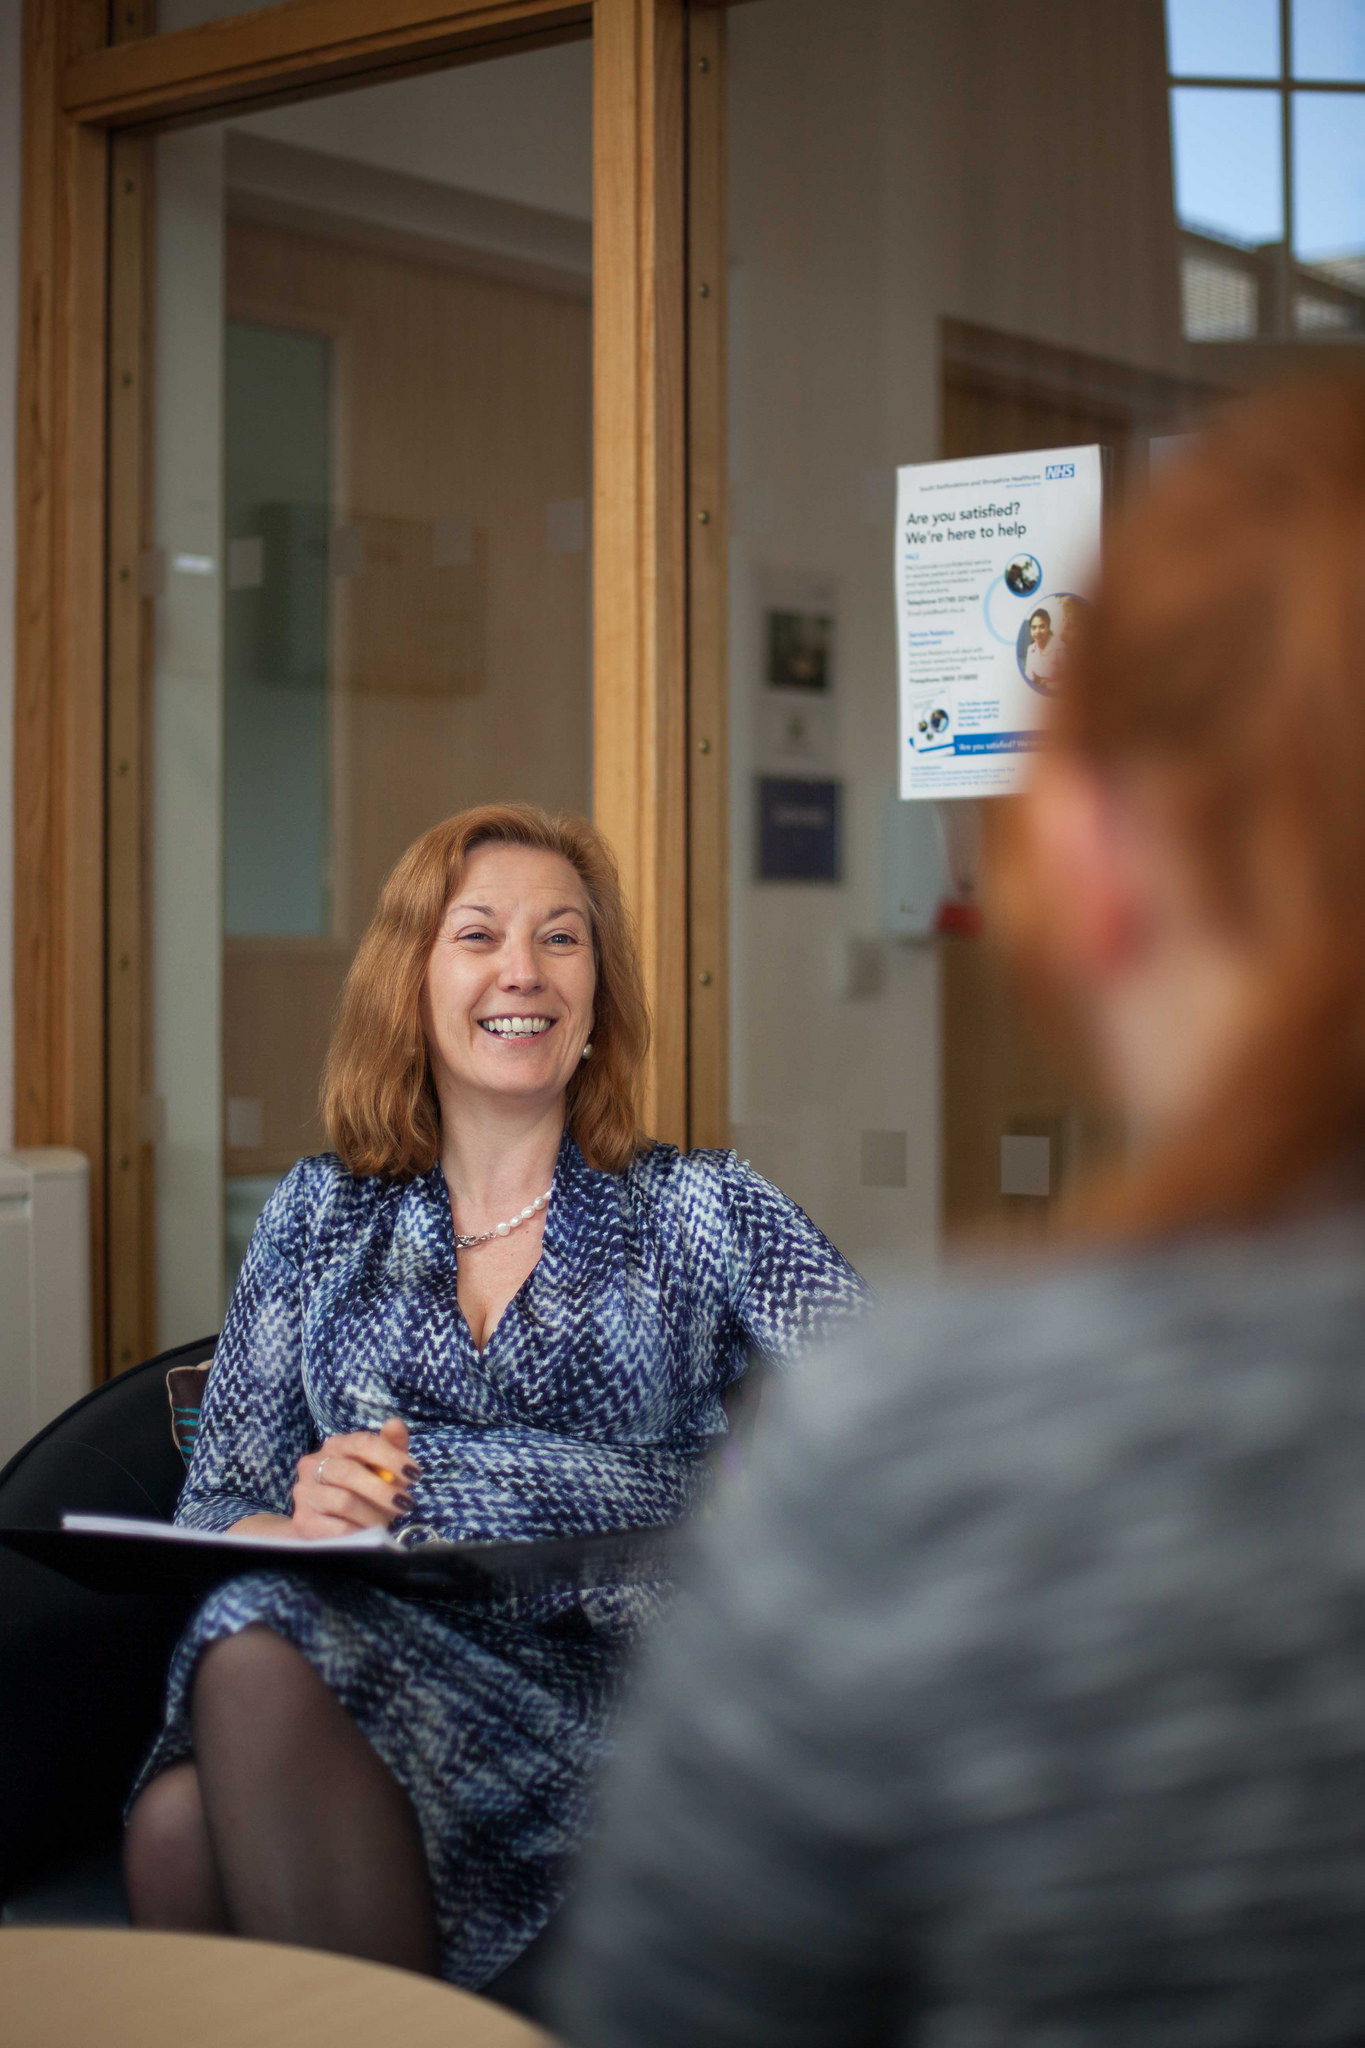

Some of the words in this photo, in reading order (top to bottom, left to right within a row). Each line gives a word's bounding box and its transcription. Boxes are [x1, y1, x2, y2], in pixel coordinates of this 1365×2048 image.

[1047, 465, 1074, 479] NHS
[906, 513, 929, 526] Are
[931, 510, 956, 526] you
[960, 502, 1021, 520] satisfied?
[906, 528, 943, 544] We're
[947, 526, 976, 542] here
[980, 527, 994, 538] to
[998, 522, 1027, 538] help
[972, 743, 985, 752] you
